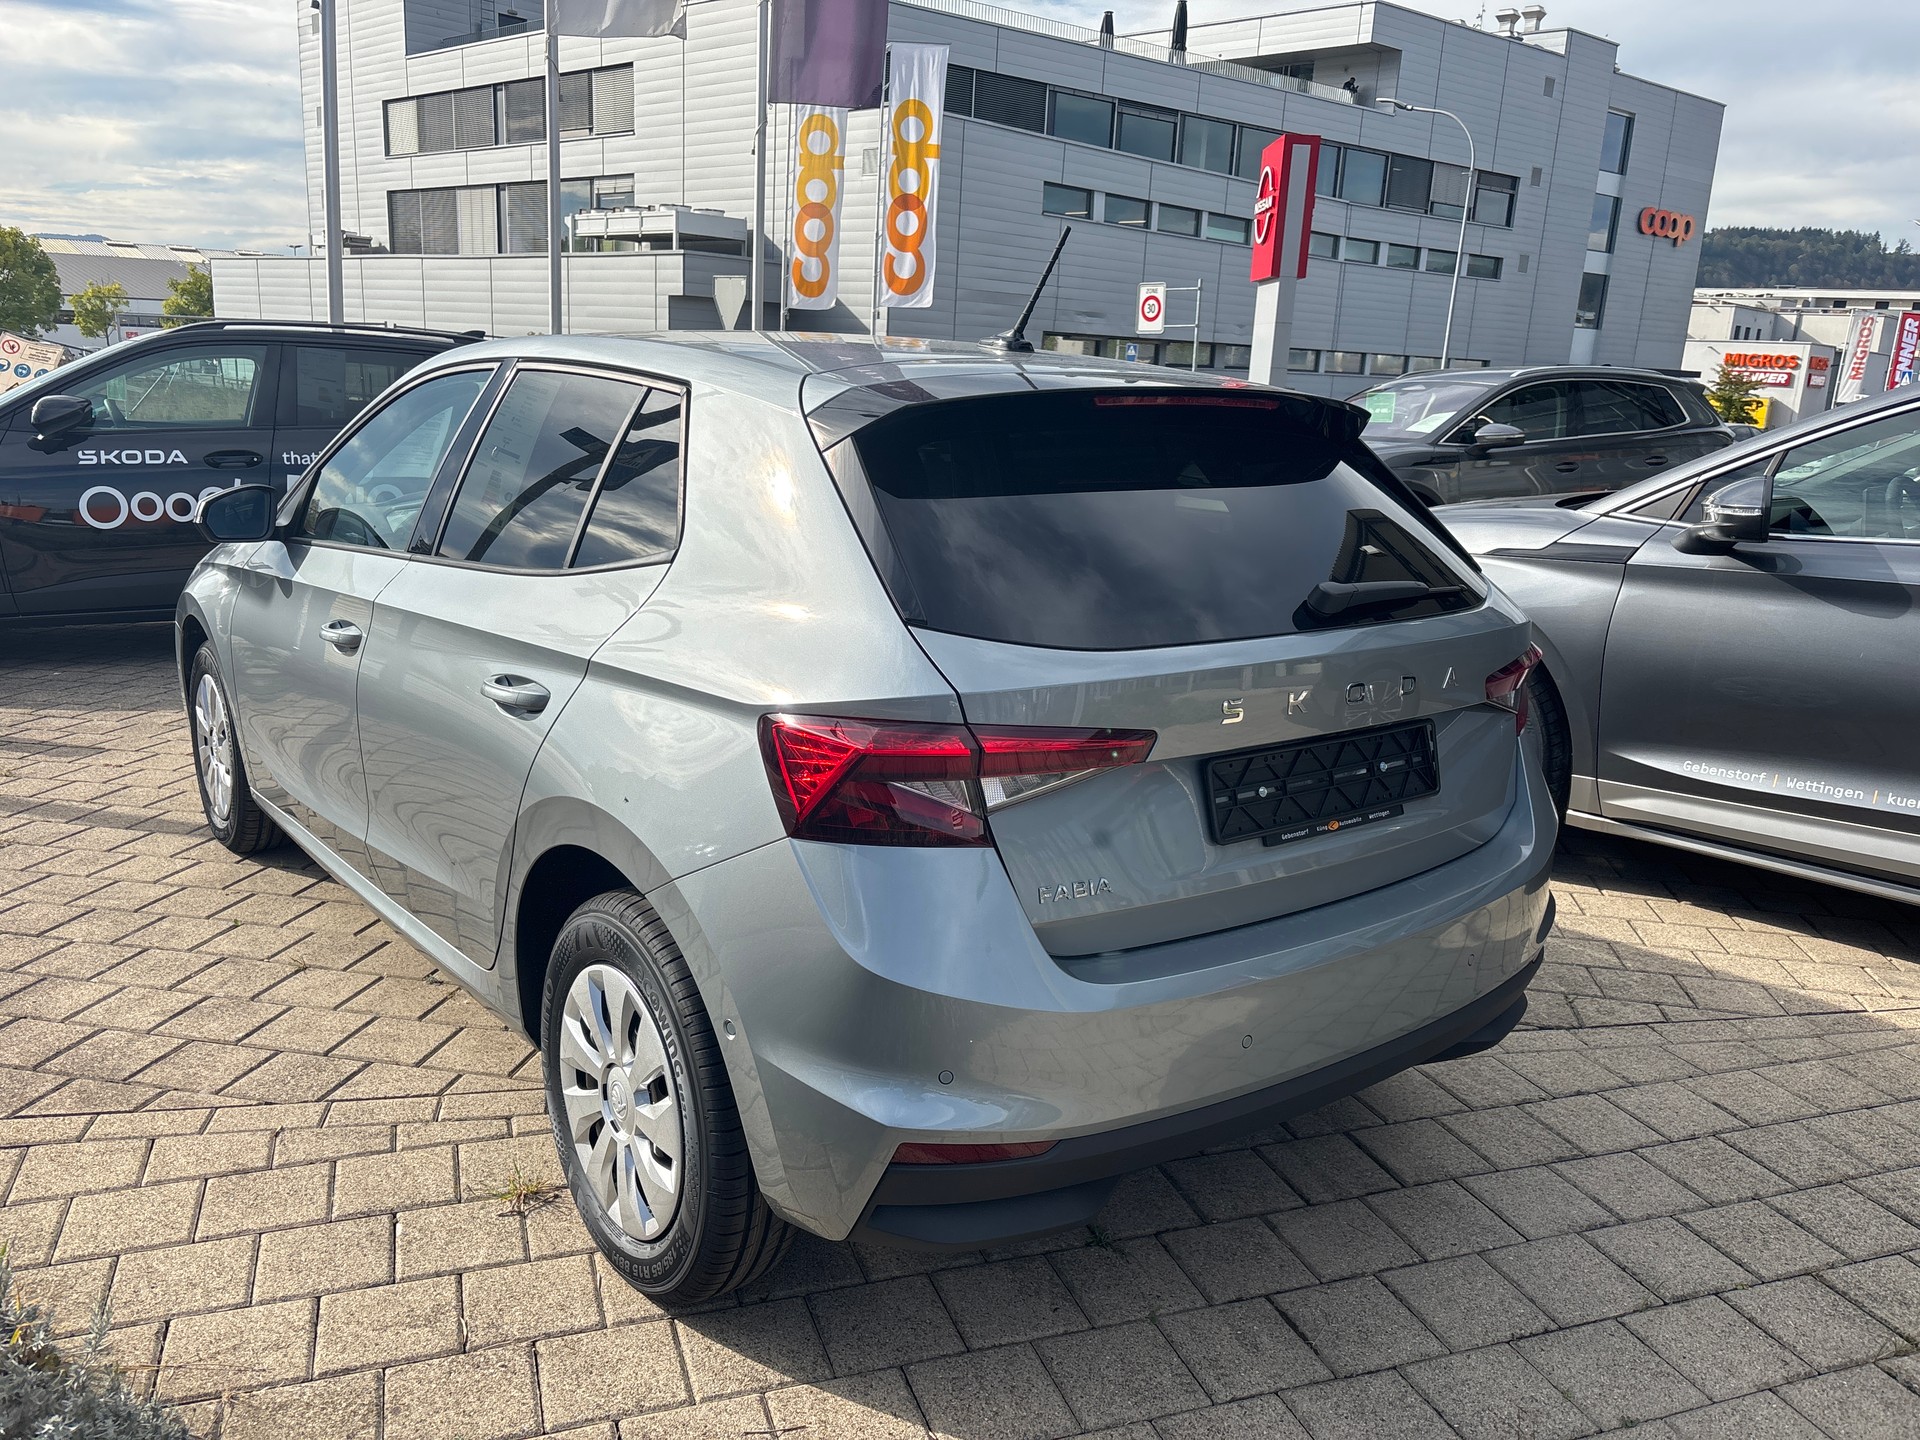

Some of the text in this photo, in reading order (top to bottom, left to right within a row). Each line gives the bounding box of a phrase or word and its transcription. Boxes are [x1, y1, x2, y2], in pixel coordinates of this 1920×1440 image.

[791, 113, 845, 298] coop
[883, 98, 941, 297] coop
[1640, 206, 1696, 248] coop
[1146, 303, 1156, 313] 30
[1724, 353, 1799, 369] MIGROS
[1849, 314, 1876, 380] MIGROS
[1683, 760, 1767, 784] Gebenstorf
[1786, 777, 1864, 800] Wettingen
[1281, 828, 1309, 840] Gebenstorf
[1368, 810, 1391, 820] Wettingen
[1038, 877, 1113, 904] FABIA
